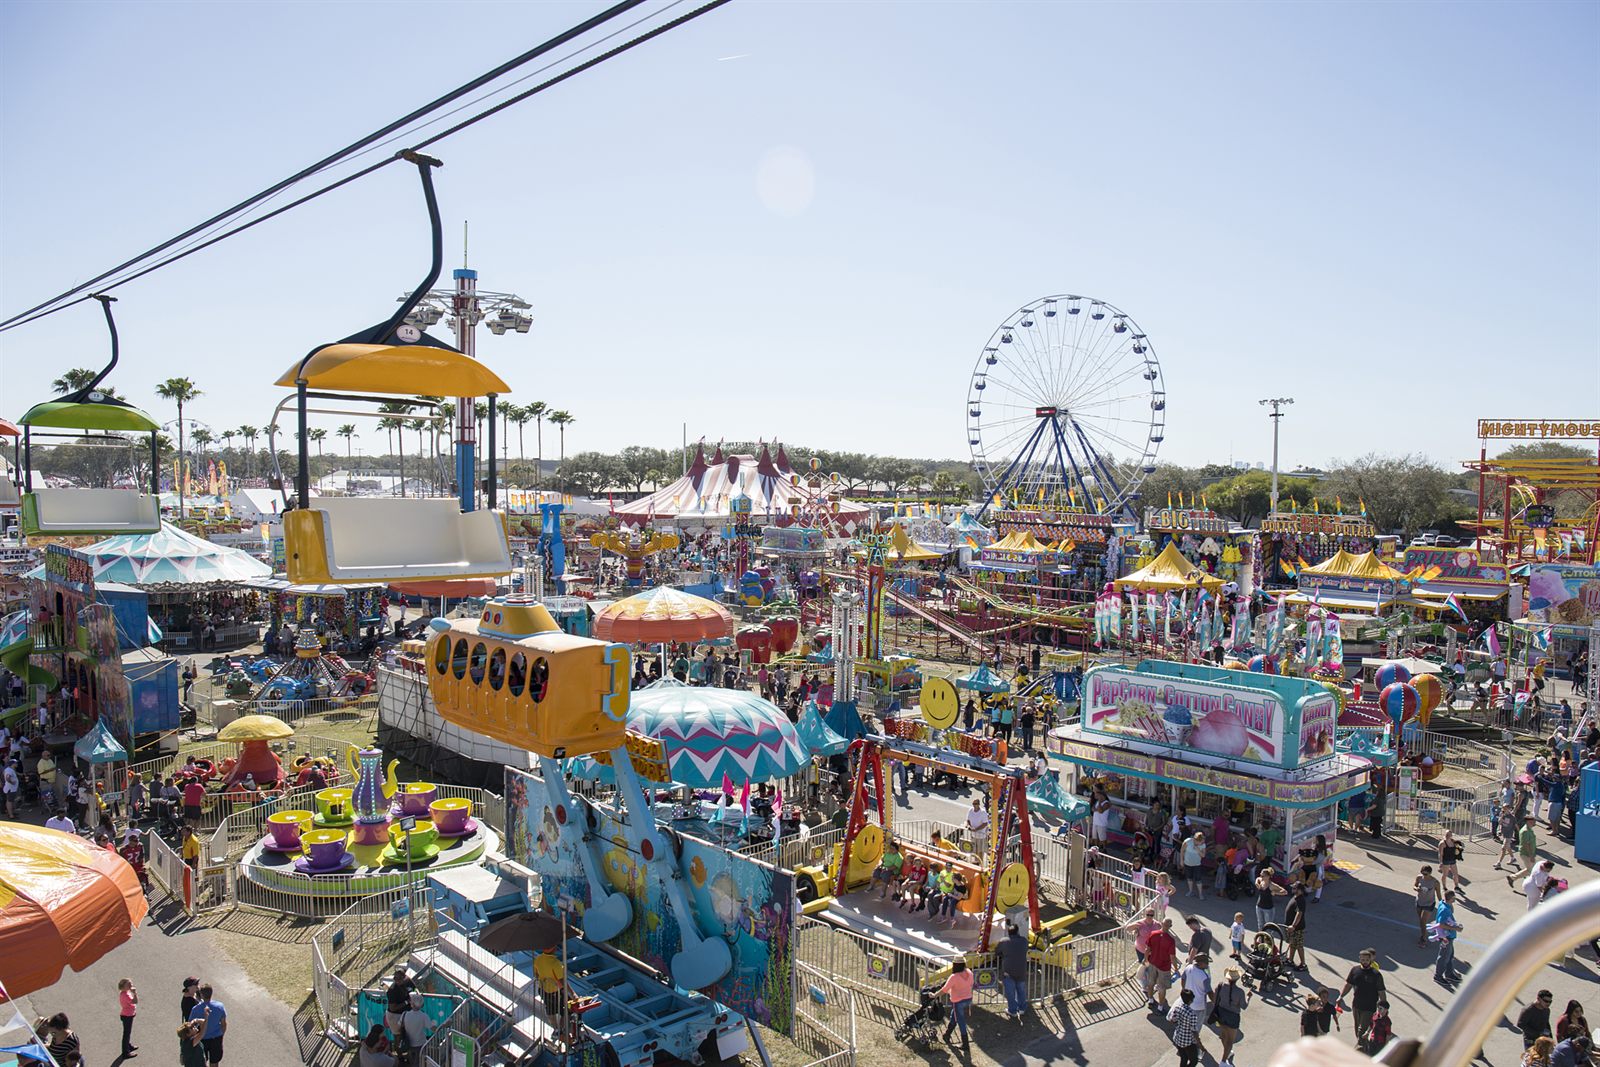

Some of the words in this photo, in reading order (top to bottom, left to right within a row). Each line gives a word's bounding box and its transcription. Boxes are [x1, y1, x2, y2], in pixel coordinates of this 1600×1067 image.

[405, 328, 414, 336] 14
[1161, 510, 1190, 529] BIG
[1301, 515, 1334, 534] BIG
[1335, 523, 1375, 537] PRIZES
[864, 546, 889, 561] STAR
[1404, 551, 1454, 567] PRIZE
[1439, 566, 1480, 578] TIME
[1561, 569, 1597, 577] COTTON
[1167, 764, 1206, 782] CANDY
[1219, 775, 1267, 795] APPLES
